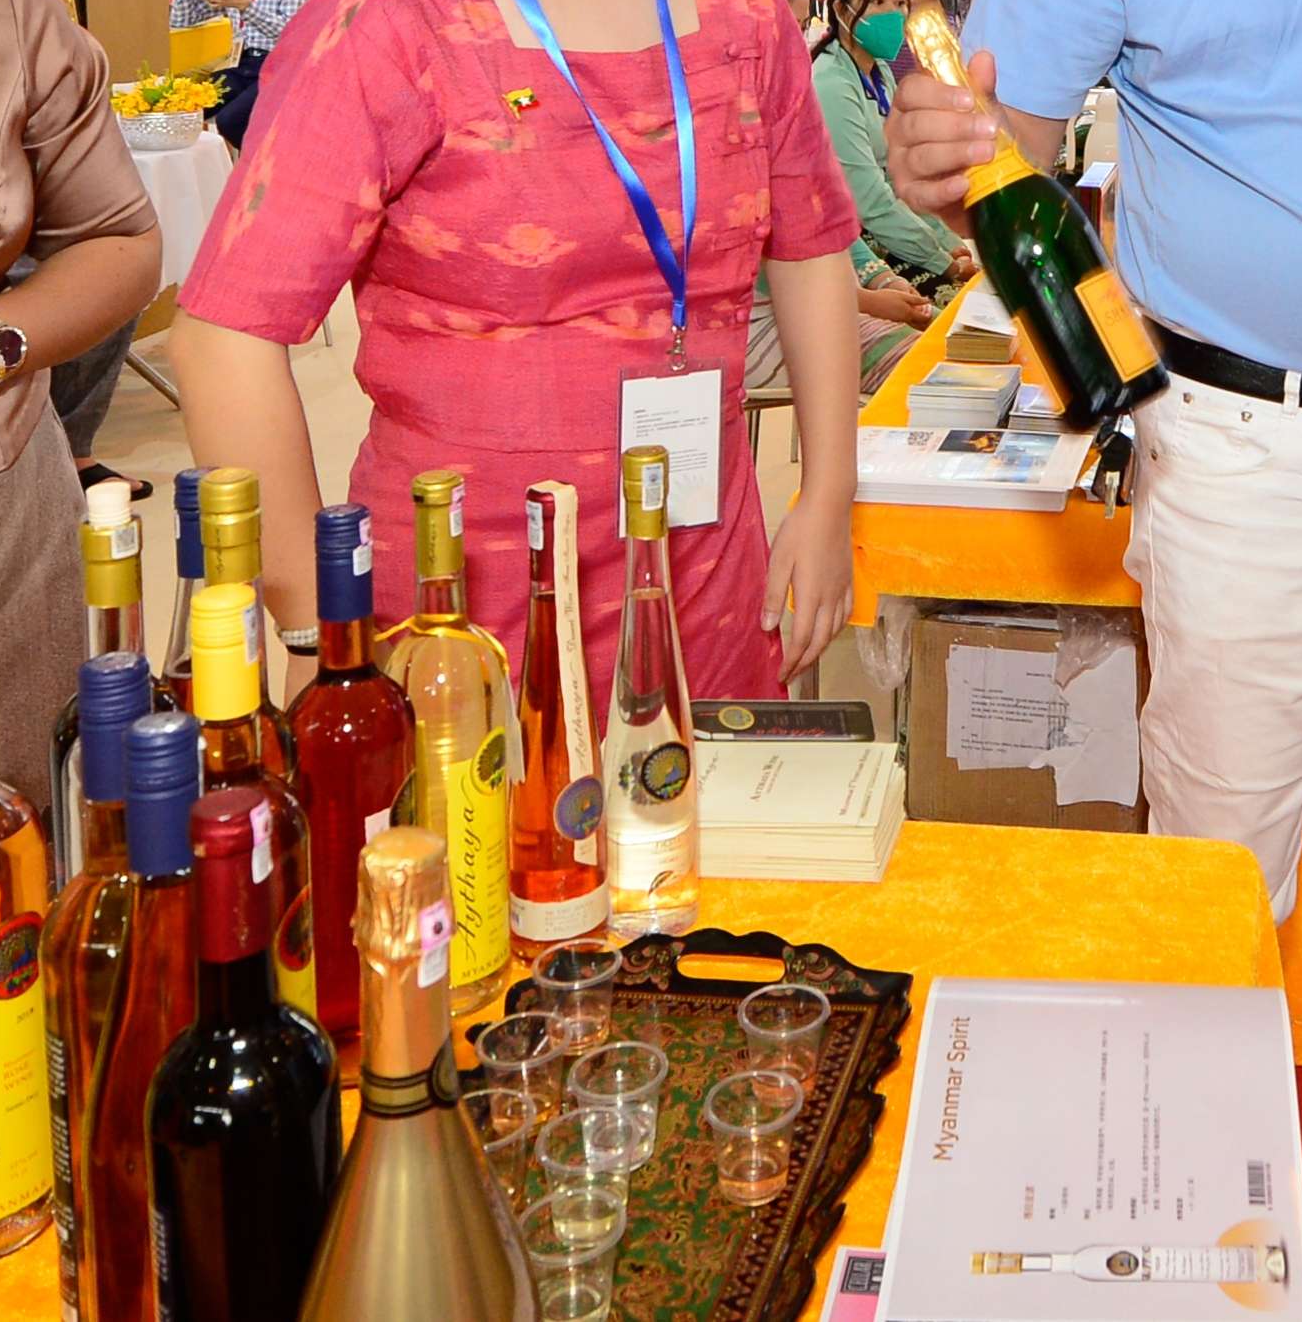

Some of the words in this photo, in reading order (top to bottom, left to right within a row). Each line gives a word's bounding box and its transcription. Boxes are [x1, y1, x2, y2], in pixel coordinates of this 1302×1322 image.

[456, 775, 483, 962] Aythaya
[932, 1067, 962, 1162] Myanmar
[947, 1015, 972, 1063] Spirit
